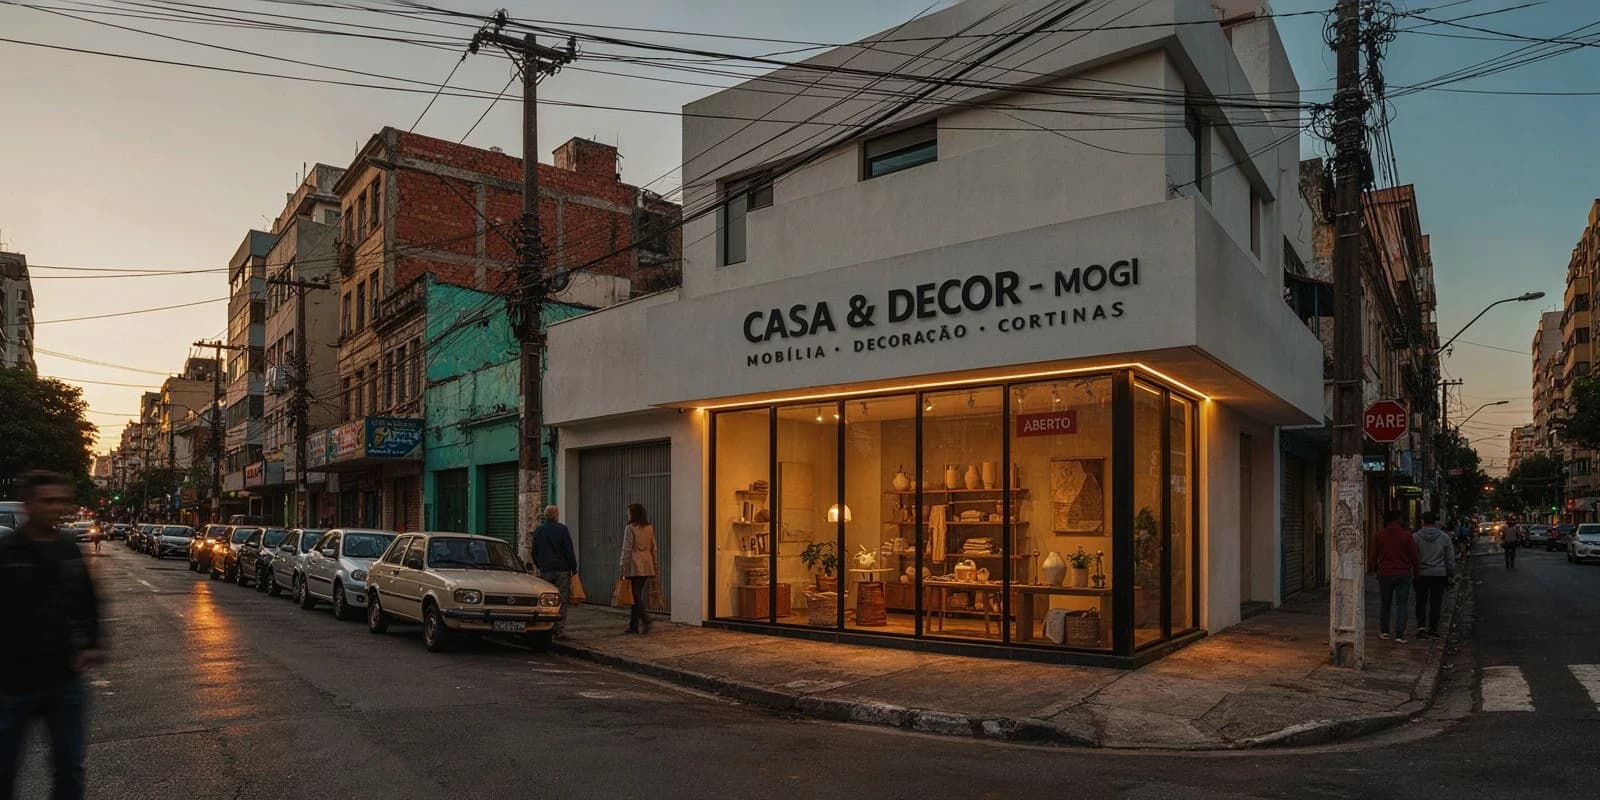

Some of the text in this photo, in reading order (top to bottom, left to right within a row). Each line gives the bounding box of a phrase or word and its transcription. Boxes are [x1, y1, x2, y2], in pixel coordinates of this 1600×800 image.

[743, 301, 836, 343] CASA
[846, 294, 875, 329] &
[888, 271, 1023, 324] DECOR
[1055, 258, 1139, 297] MOGI
[747, 345, 826, 367] MOBÍLIA
[854, 324, 967, 353] DECORAÇÃO
[998, 301, 1125, 333] CORTINAS
[1023, 418, 1070, 432] ABERTO
[1366, 414, 1405, 428] PARE
